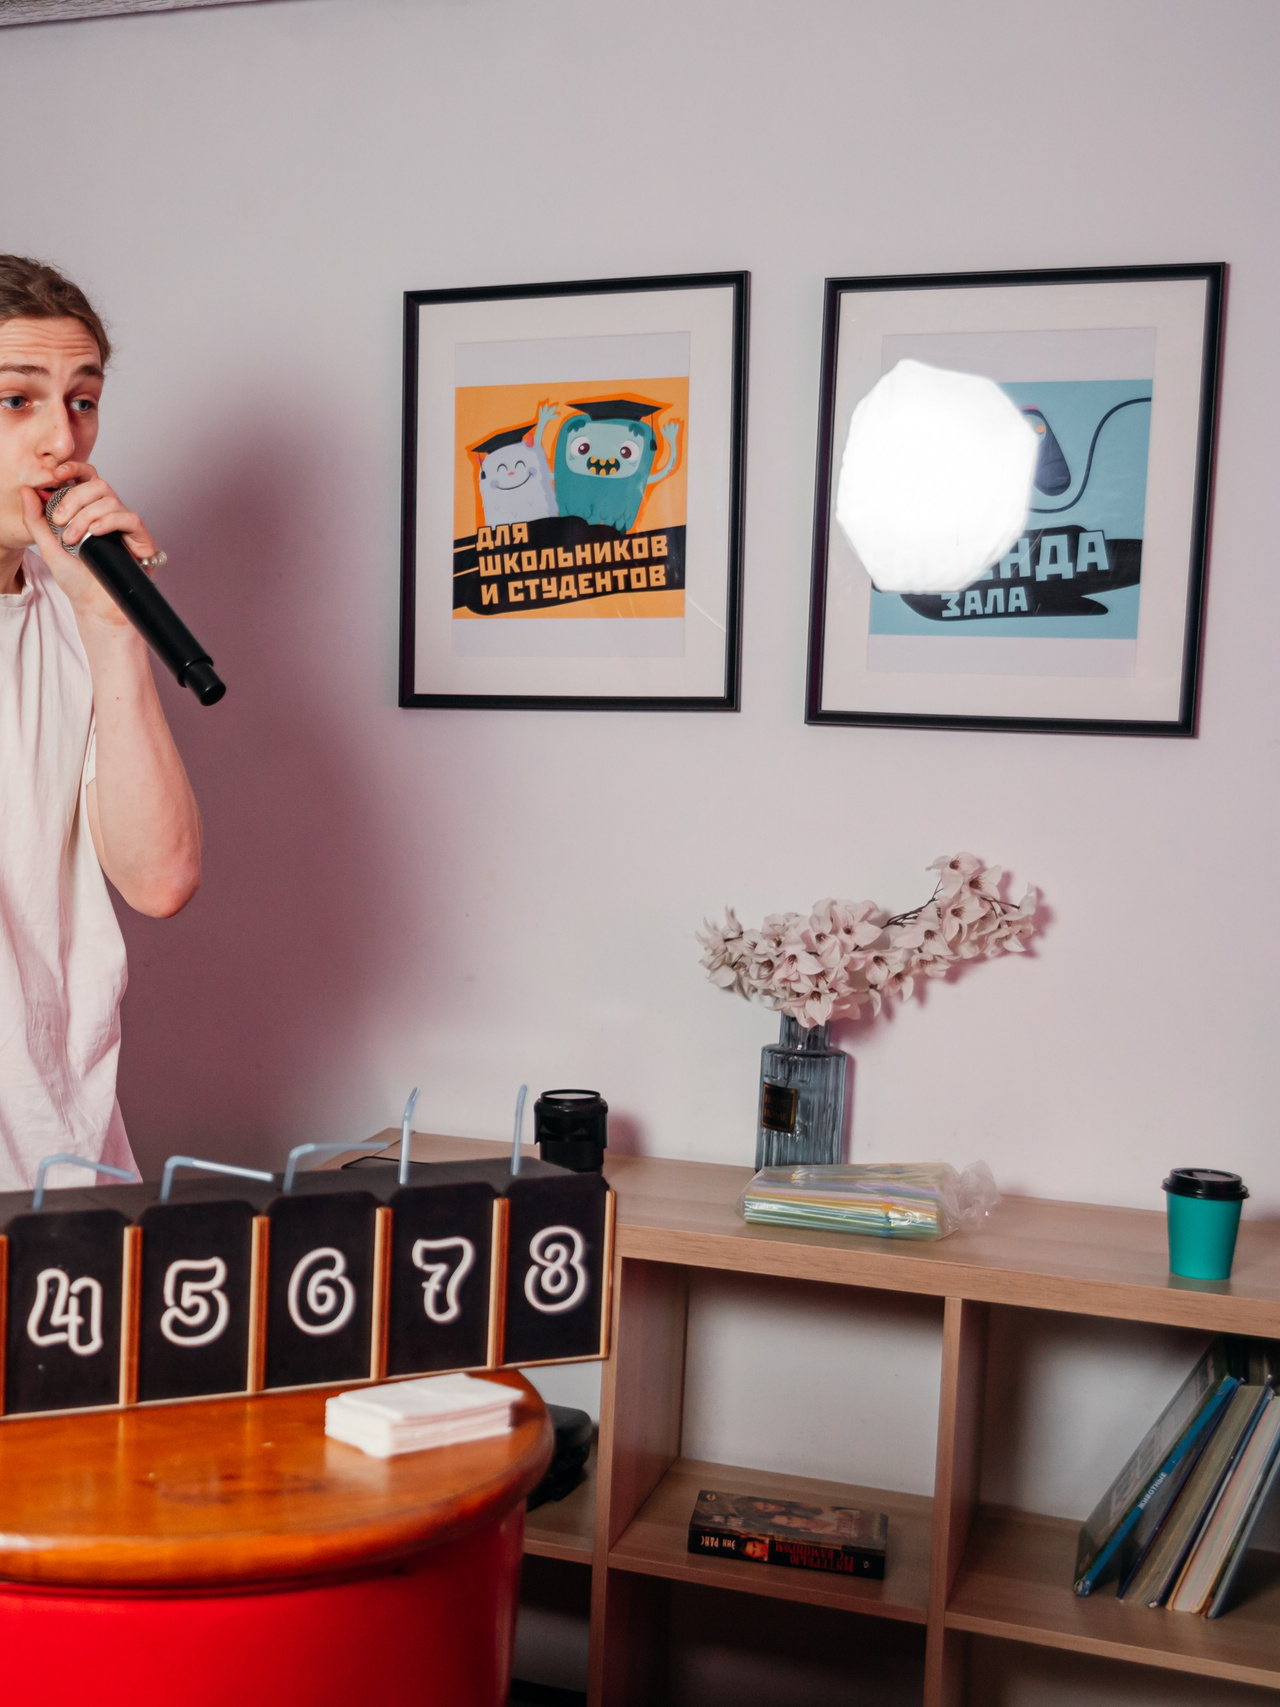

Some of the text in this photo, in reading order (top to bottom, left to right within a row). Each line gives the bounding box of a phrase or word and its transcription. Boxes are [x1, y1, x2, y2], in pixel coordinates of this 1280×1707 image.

[476, 521, 530, 551] ДЛЯ
[478, 535, 669, 577] ШКОЛЬНИКОВ
[975, 530, 1109, 582] НДА
[481, 564, 667, 606] И СТУДЕНТОВ
[941, 586, 1029, 618] ЗАЛА
[26, 1267, 104, 1356] 4
[160, 1256, 230, 1346] 5
[287, 1247, 356, 1336] 6
[412, 1236, 475, 1324] 7
[523, 1225, 588, 1314] 8
[1138, 1472, 1167, 1510] ЖИВОТНЫЕ
